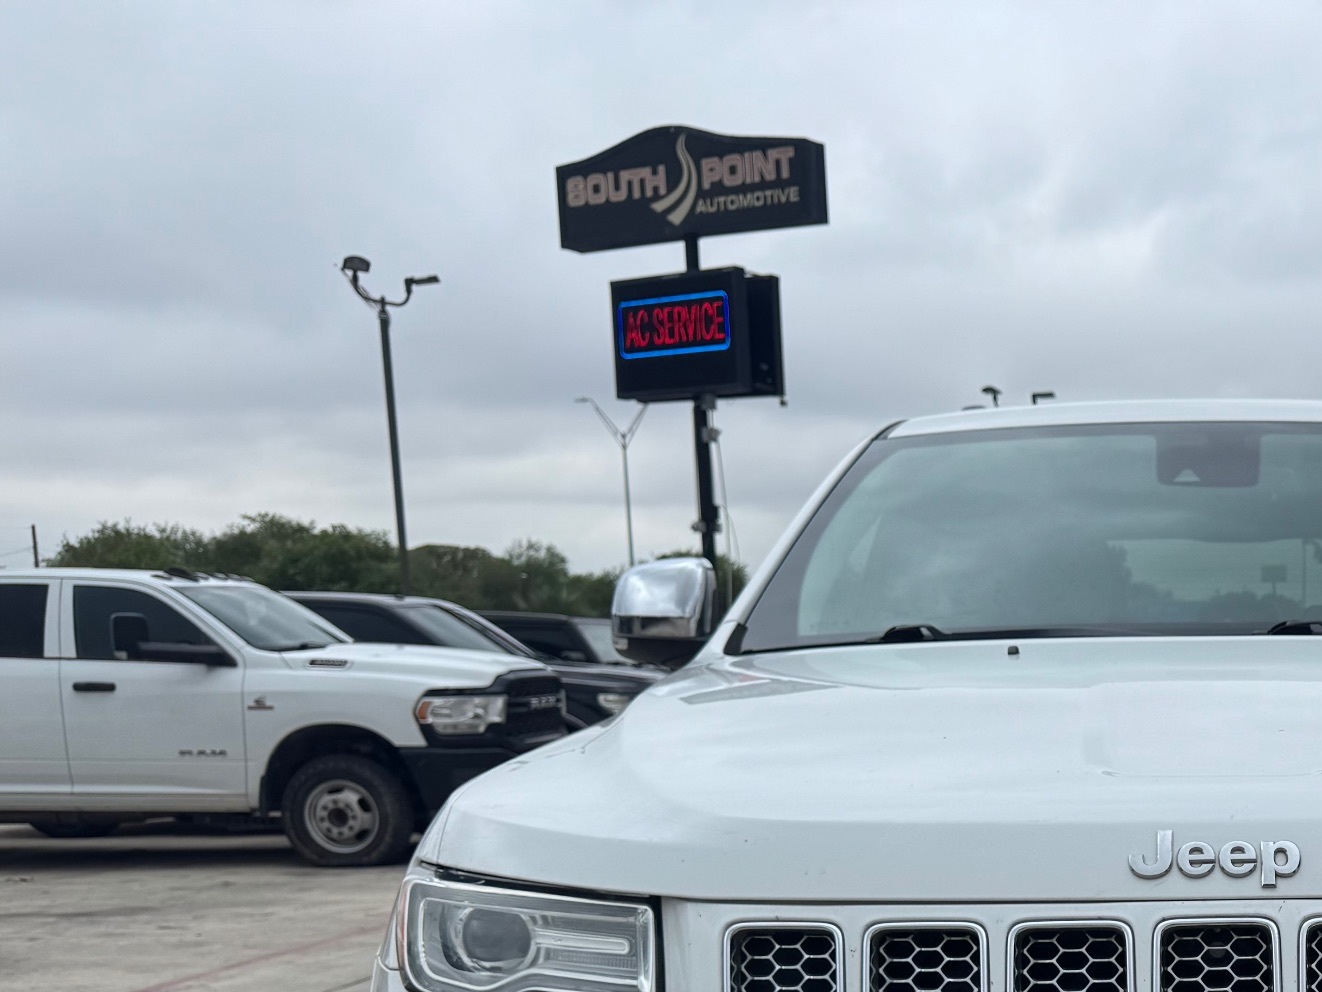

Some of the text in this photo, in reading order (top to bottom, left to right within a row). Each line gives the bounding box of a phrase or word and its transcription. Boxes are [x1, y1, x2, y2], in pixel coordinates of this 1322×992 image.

[566, 146, 796, 208] SOUTH POINT
[694, 186, 800, 214] AUTOMOTIVE
[625, 301, 726, 349] AC SERVICE
[1128, 829, 1301, 888] Jeep
